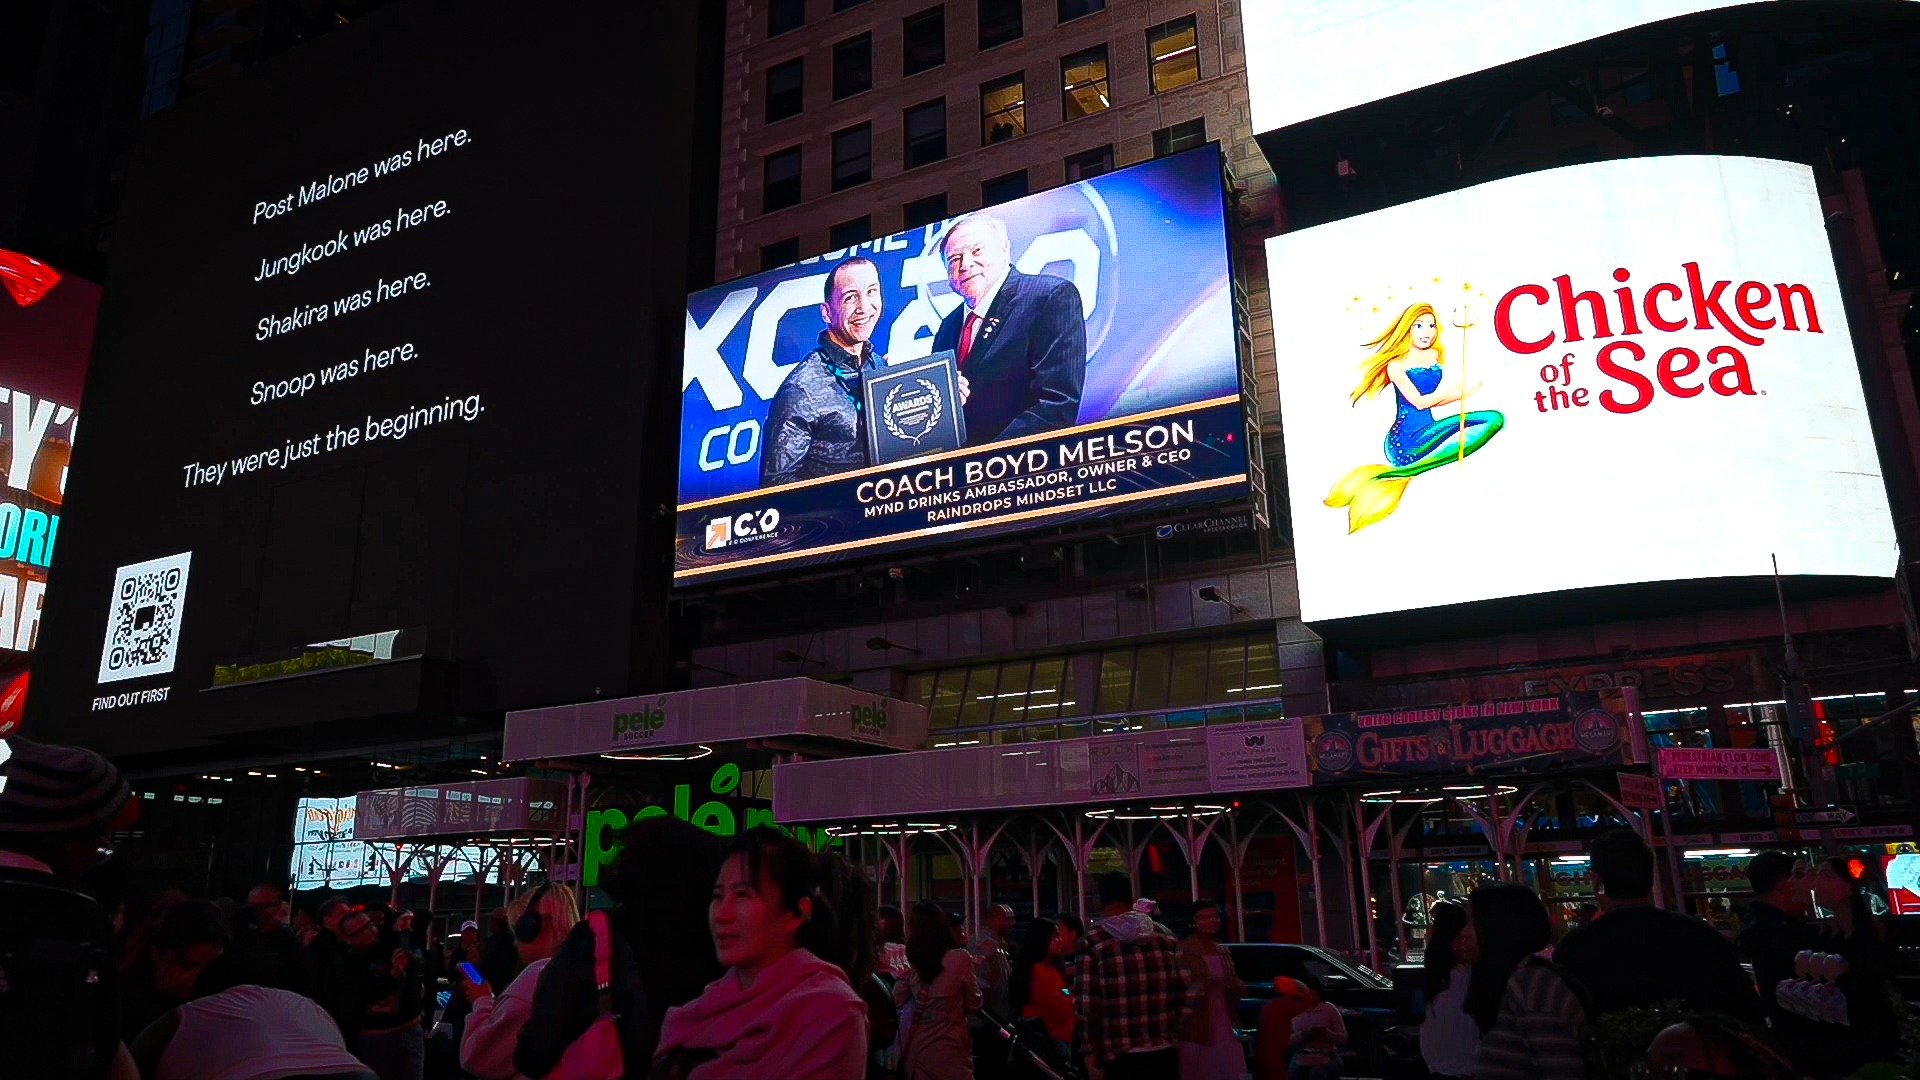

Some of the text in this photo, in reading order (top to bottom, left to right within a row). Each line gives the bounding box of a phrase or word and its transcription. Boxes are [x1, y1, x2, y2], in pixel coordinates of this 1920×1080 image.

[252, 130, 472, 225] Post Malone was here.
[254, 201, 451, 282] Jungkook was here.
[255, 273, 431, 341] Shakira was here.
[1493, 261, 1824, 355] Chicken
[250, 343, 419, 406] Snoop was here.
[1534, 340, 1759, 415] the Sea
[1540, 352, 1578, 388] of
[892, 394, 933, 413] AWARDS
[183, 395, 485, 488] They were just the beginning.
[856, 419, 1195, 503] COACH BOYD MELSON
[864, 448, 1192, 518] MYND DRINKS AMBASSADOR, OWNER & CEO
[927, 478, 1118, 523] RAINDROPS MINDSET LLC
[91, 687, 171, 712] FIND OUT FIRST
[612, 695, 667, 742] pelé
[1357, 714, 1392, 728] VOTED
[1393, 709, 1441, 724] COOLEST
[1443, 705, 1479, 720] STORE
[1496, 700, 1525, 715] NEW
[1526, 698, 1560, 713] YORK
[623, 730, 655, 740] SOCCER
[1357, 731, 1428, 768] GIFTS
[1448, 721, 1578, 760] LUGGAGE
[1671, 751, 1772, 763] PEDESTRIAN FLOW ZONE
[1672, 764, 1728, 775] KEEP MOVING
[1826, 809, 1849, 821] WAY
